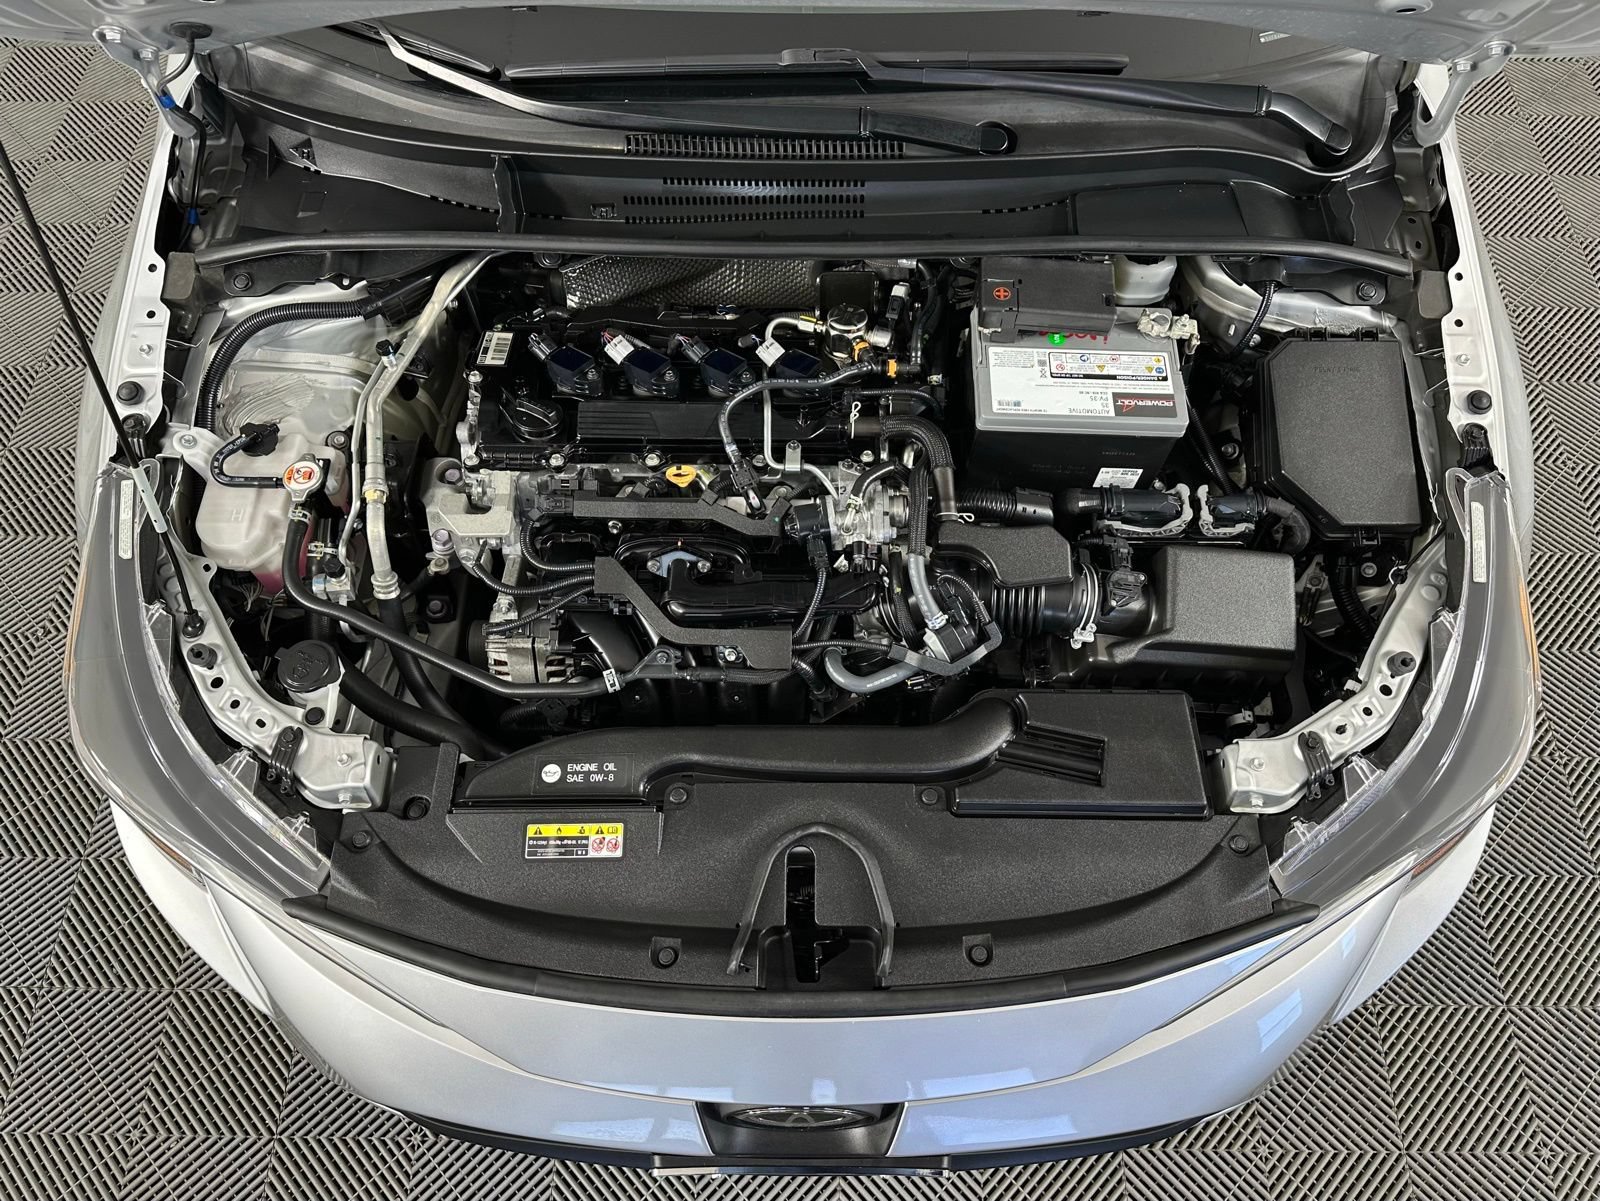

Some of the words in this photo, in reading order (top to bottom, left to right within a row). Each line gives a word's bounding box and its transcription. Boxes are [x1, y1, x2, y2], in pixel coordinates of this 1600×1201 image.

[1115, 398, 1174, 408] POWERVOLT
[566, 763, 599, 772] ENGINE
[603, 762, 617, 771] OIL
[566, 774, 584, 783] SAE
[589, 773, 614, 782] 0W-8
